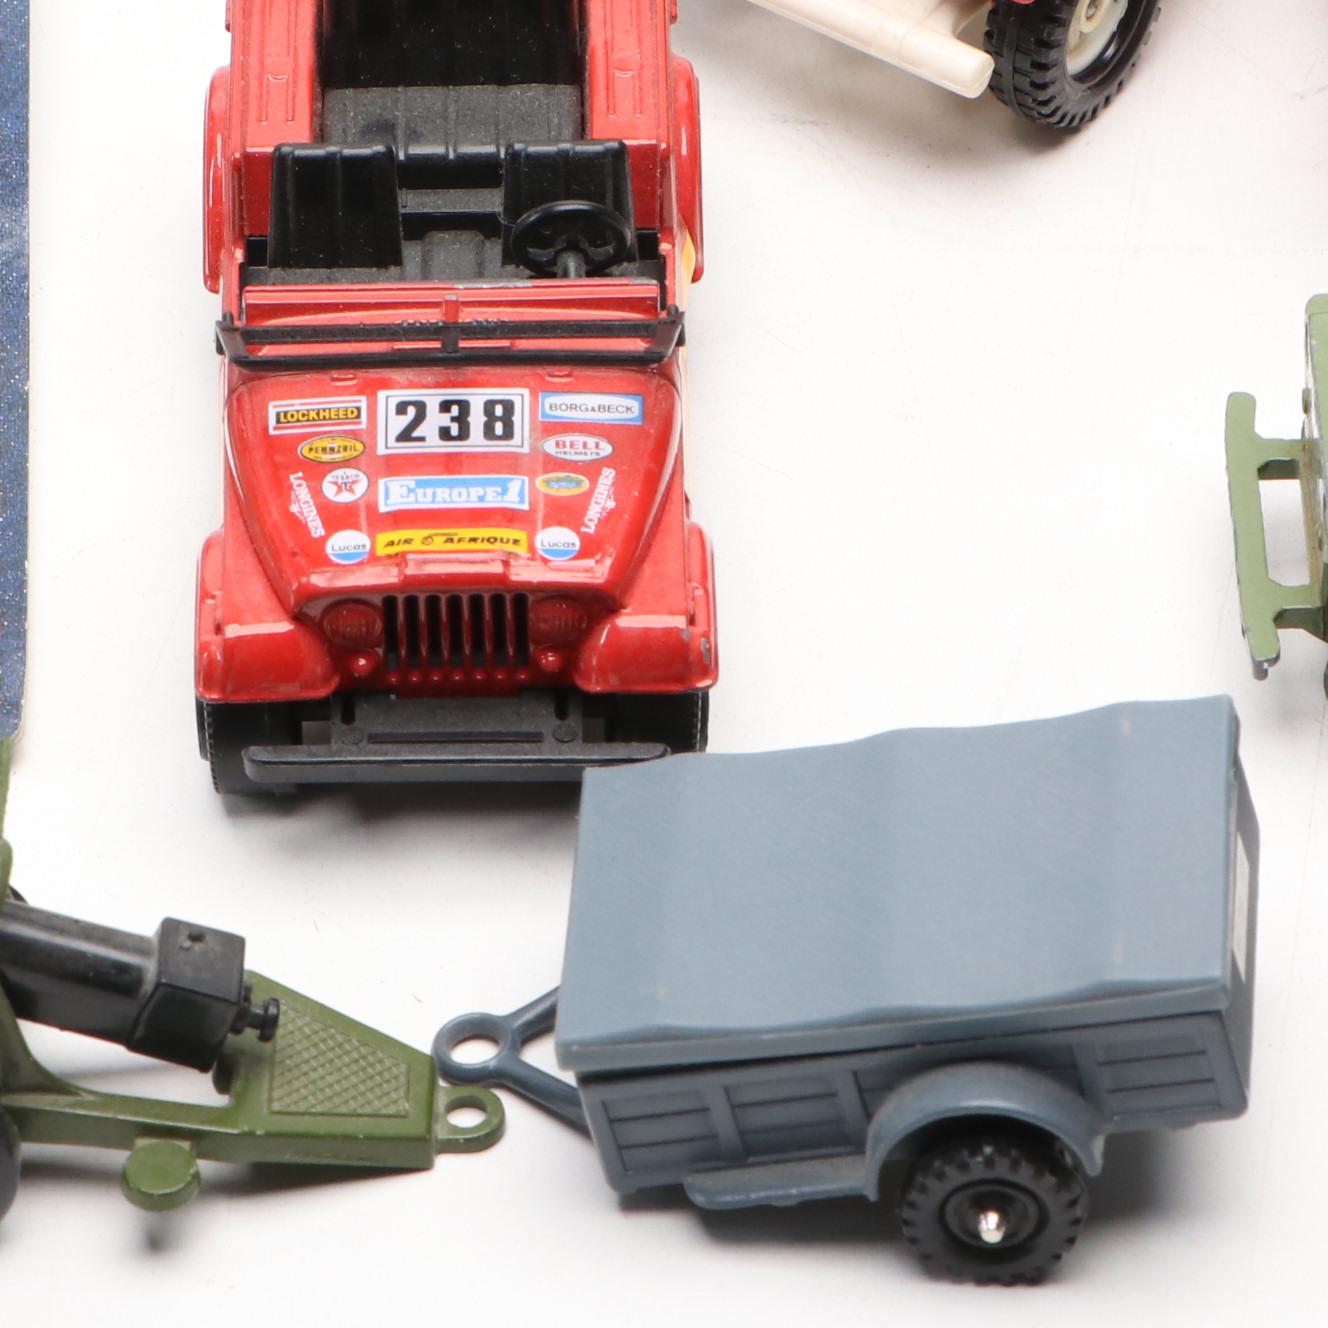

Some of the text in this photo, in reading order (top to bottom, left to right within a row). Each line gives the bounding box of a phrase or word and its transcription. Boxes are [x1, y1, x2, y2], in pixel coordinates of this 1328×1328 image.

[279, 407, 359, 423] LOCKHEED
[394, 398, 516, 443] 238
[554, 439, 606, 451] BELL
[288, 471, 326, 539] LONGINES
[580, 467, 617, 535] LONGINES
[331, 543, 368, 552] Lucas
[383, 535, 522, 548] AIR AFRIQUE
[540, 539, 577, 549] Lucas
